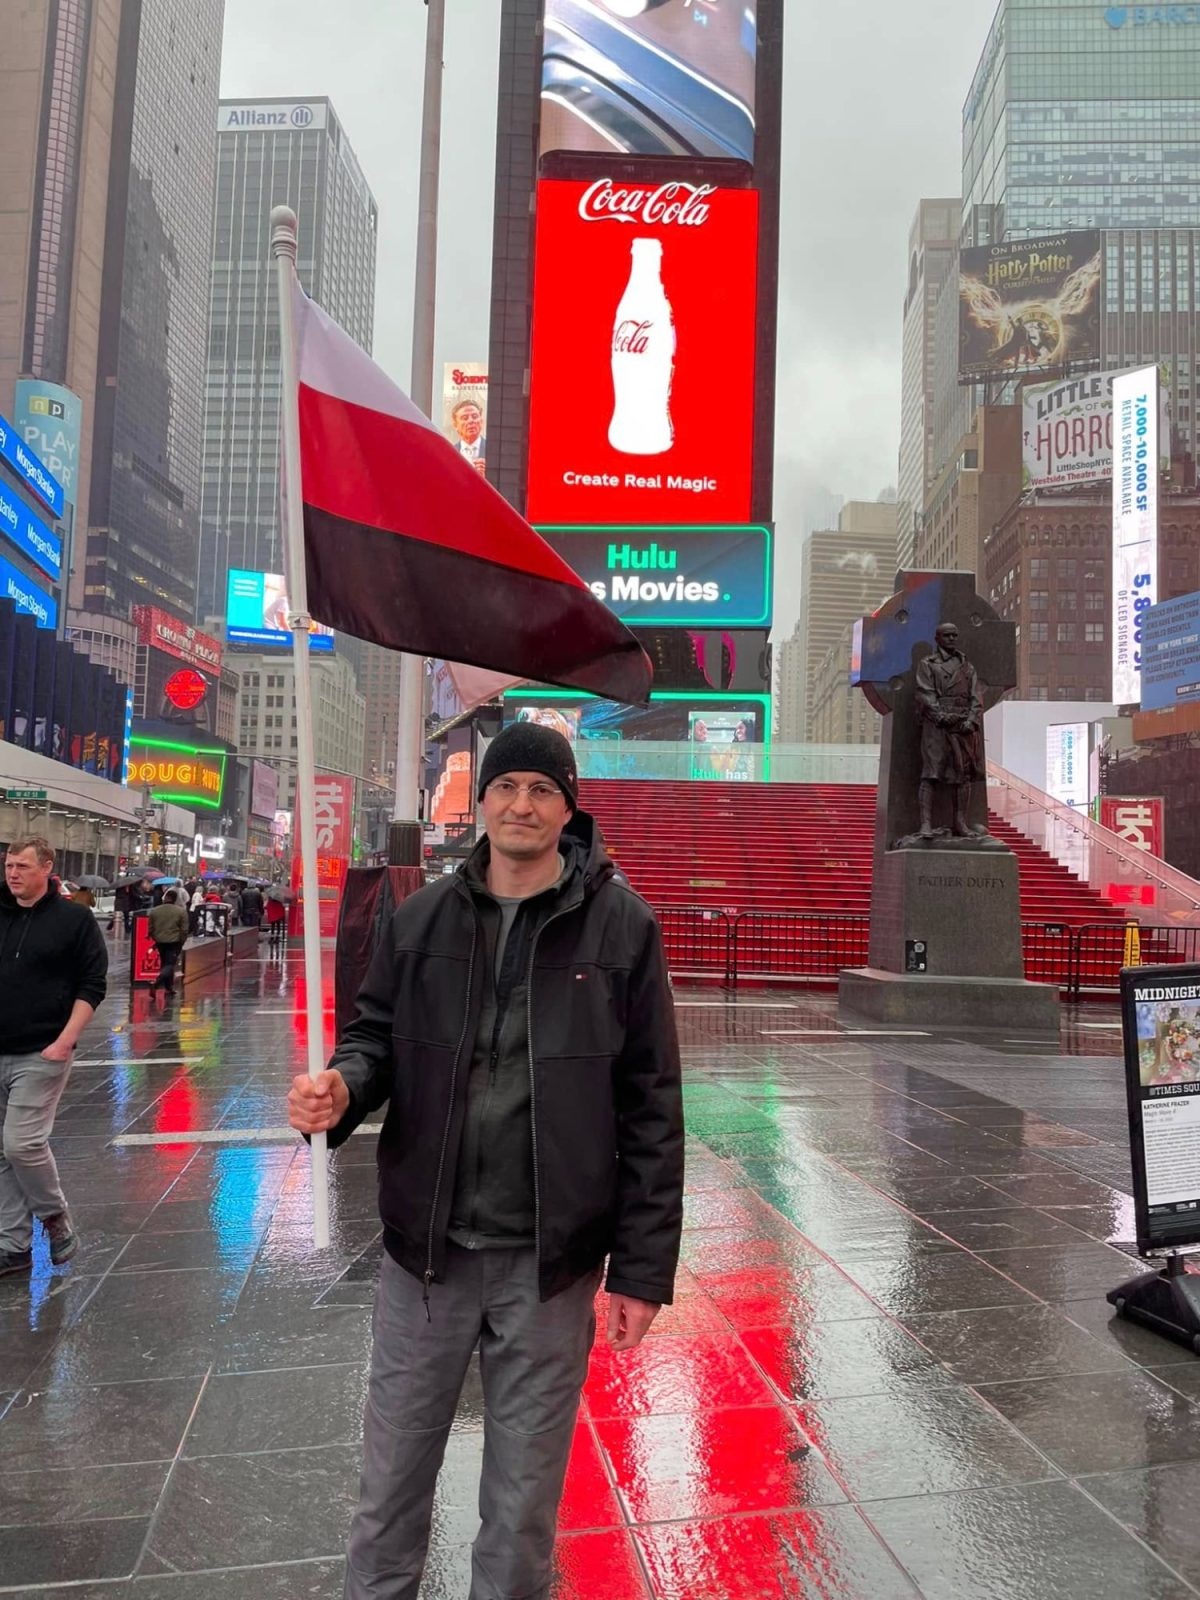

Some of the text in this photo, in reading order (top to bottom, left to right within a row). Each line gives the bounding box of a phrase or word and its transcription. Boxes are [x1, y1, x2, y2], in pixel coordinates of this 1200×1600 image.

[227, 109, 287, 126] Allianz
[578, 177, 718, 226] Coca-Cola
[1011, 238, 1068, 253] BROADWAY
[986, 253, 1073, 286] Harry Potter
[1036, 377, 1102, 420] LITTLE
[1085, 402, 1099, 411] OF
[1121, 399, 1132, 516] RETAIL SPACE AVAILABLE
[1134, 394, 1148, 511] 7,000-10,000 SF
[16, 443, 56, 502] Morgan Stanley
[562, 471, 718, 493] Create Real Magic
[1031, 474, 1066, 486] Westside
[1067, 469, 1097, 481] Theatre
[27, 522, 48, 553] Morgan
[607, 543, 678, 570] Hulu
[7, 577, 48, 626] Morgan Stanley
[1117, 589, 1128, 666] OF LED SIGNAGE
[725, 768, 748, 780] has
[918, 875, 1006, 889] FATHER DUFFY
